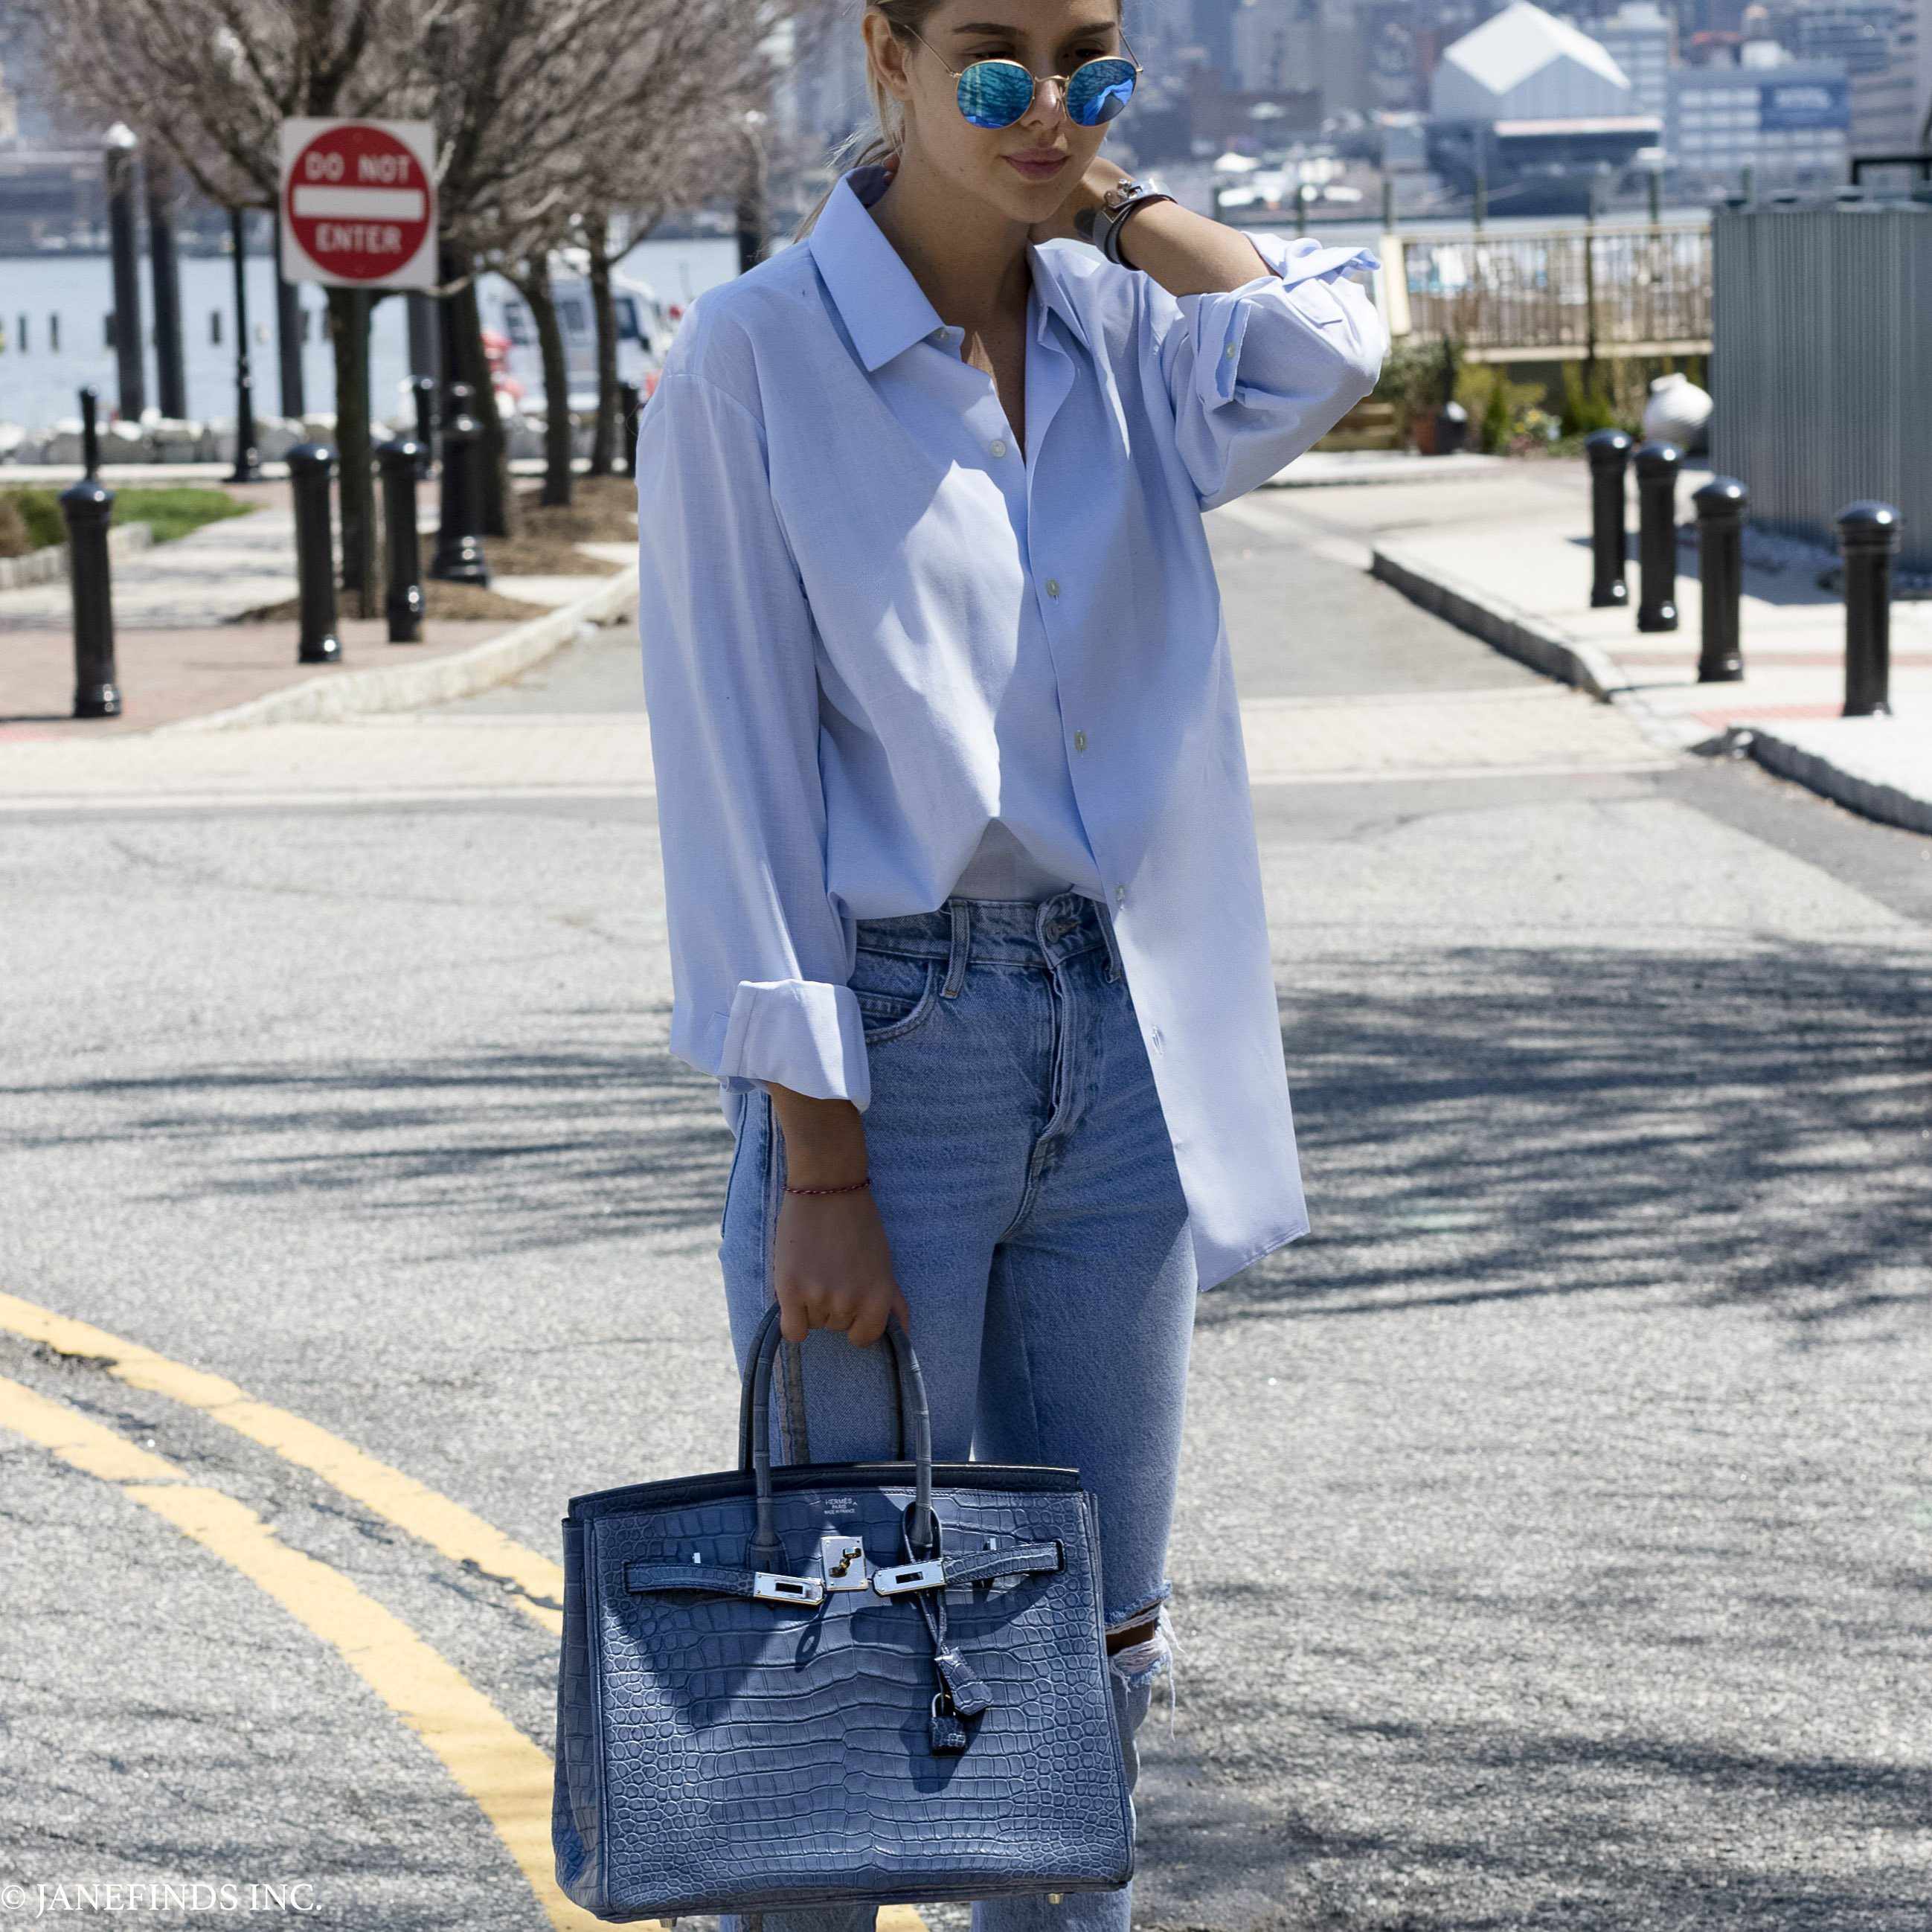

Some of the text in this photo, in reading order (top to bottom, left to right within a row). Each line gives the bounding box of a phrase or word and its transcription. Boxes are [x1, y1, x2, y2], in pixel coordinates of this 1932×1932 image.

[306, 152, 408, 184] DO NOT
[316, 224, 401, 253] ENTER
